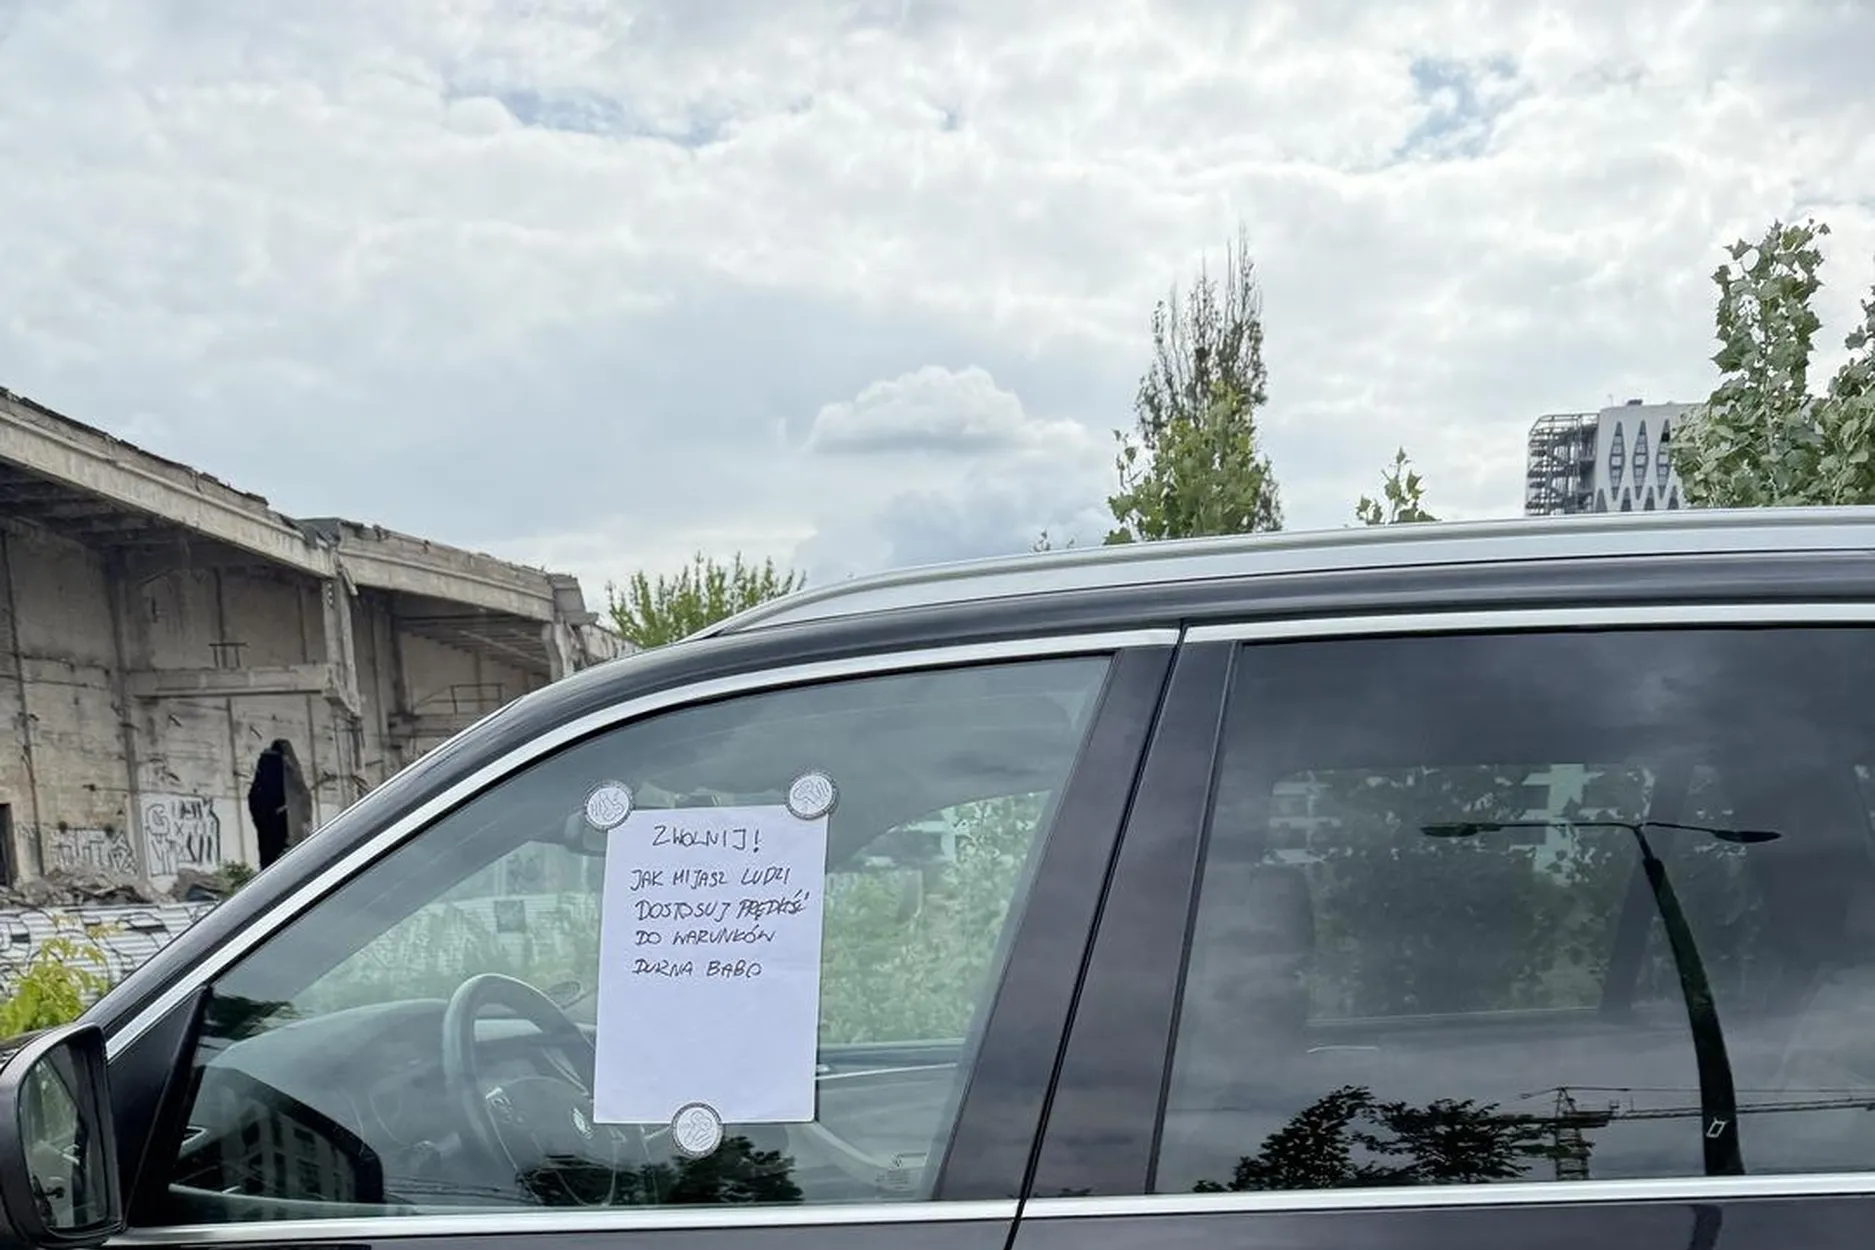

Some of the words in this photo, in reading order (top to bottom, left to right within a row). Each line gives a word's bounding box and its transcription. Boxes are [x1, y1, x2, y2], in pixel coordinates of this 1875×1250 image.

[630, 868, 663, 891] JAK
[672, 869, 728, 890] MIJASZ
[740, 867, 791, 886] LUDZI
[635, 900, 731, 923] DOSTOSUJ
[635, 930, 662, 946] DO
[672, 924, 776, 945] WARUNKÓW
[632, 958, 693, 977] DURNA
[706, 959, 762, 978] BABO
